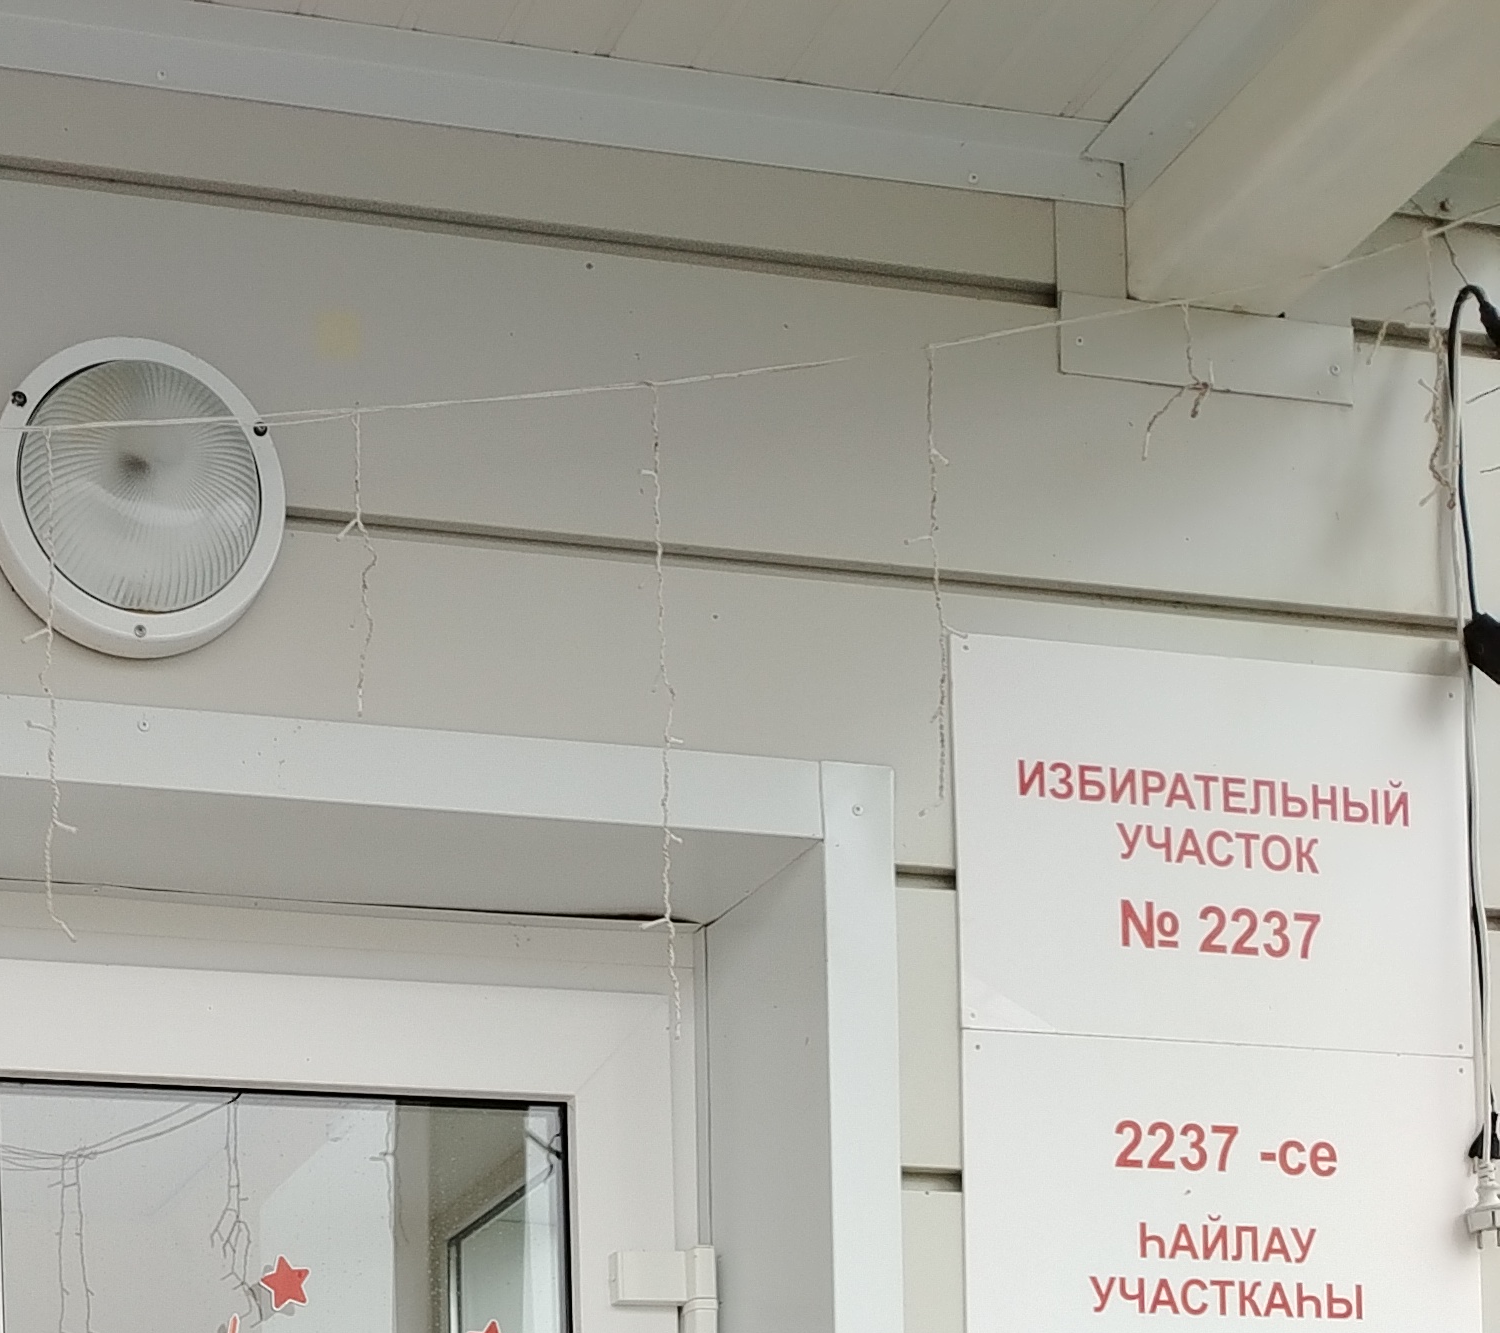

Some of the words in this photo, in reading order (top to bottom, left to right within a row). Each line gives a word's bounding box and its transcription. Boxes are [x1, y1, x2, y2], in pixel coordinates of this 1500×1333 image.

[1016, 758, 1411, 828] ИЗБИРАТЕЛЬНЫЙ
[1117, 822, 1320, 875] УЧАСТОК
[1119, 899, 1180, 950] №
[1199, 905, 1322, 960] 2237
[1114, 1120, 1240, 1174] 2237
[1259, 1136, 1339, 1177] -се
